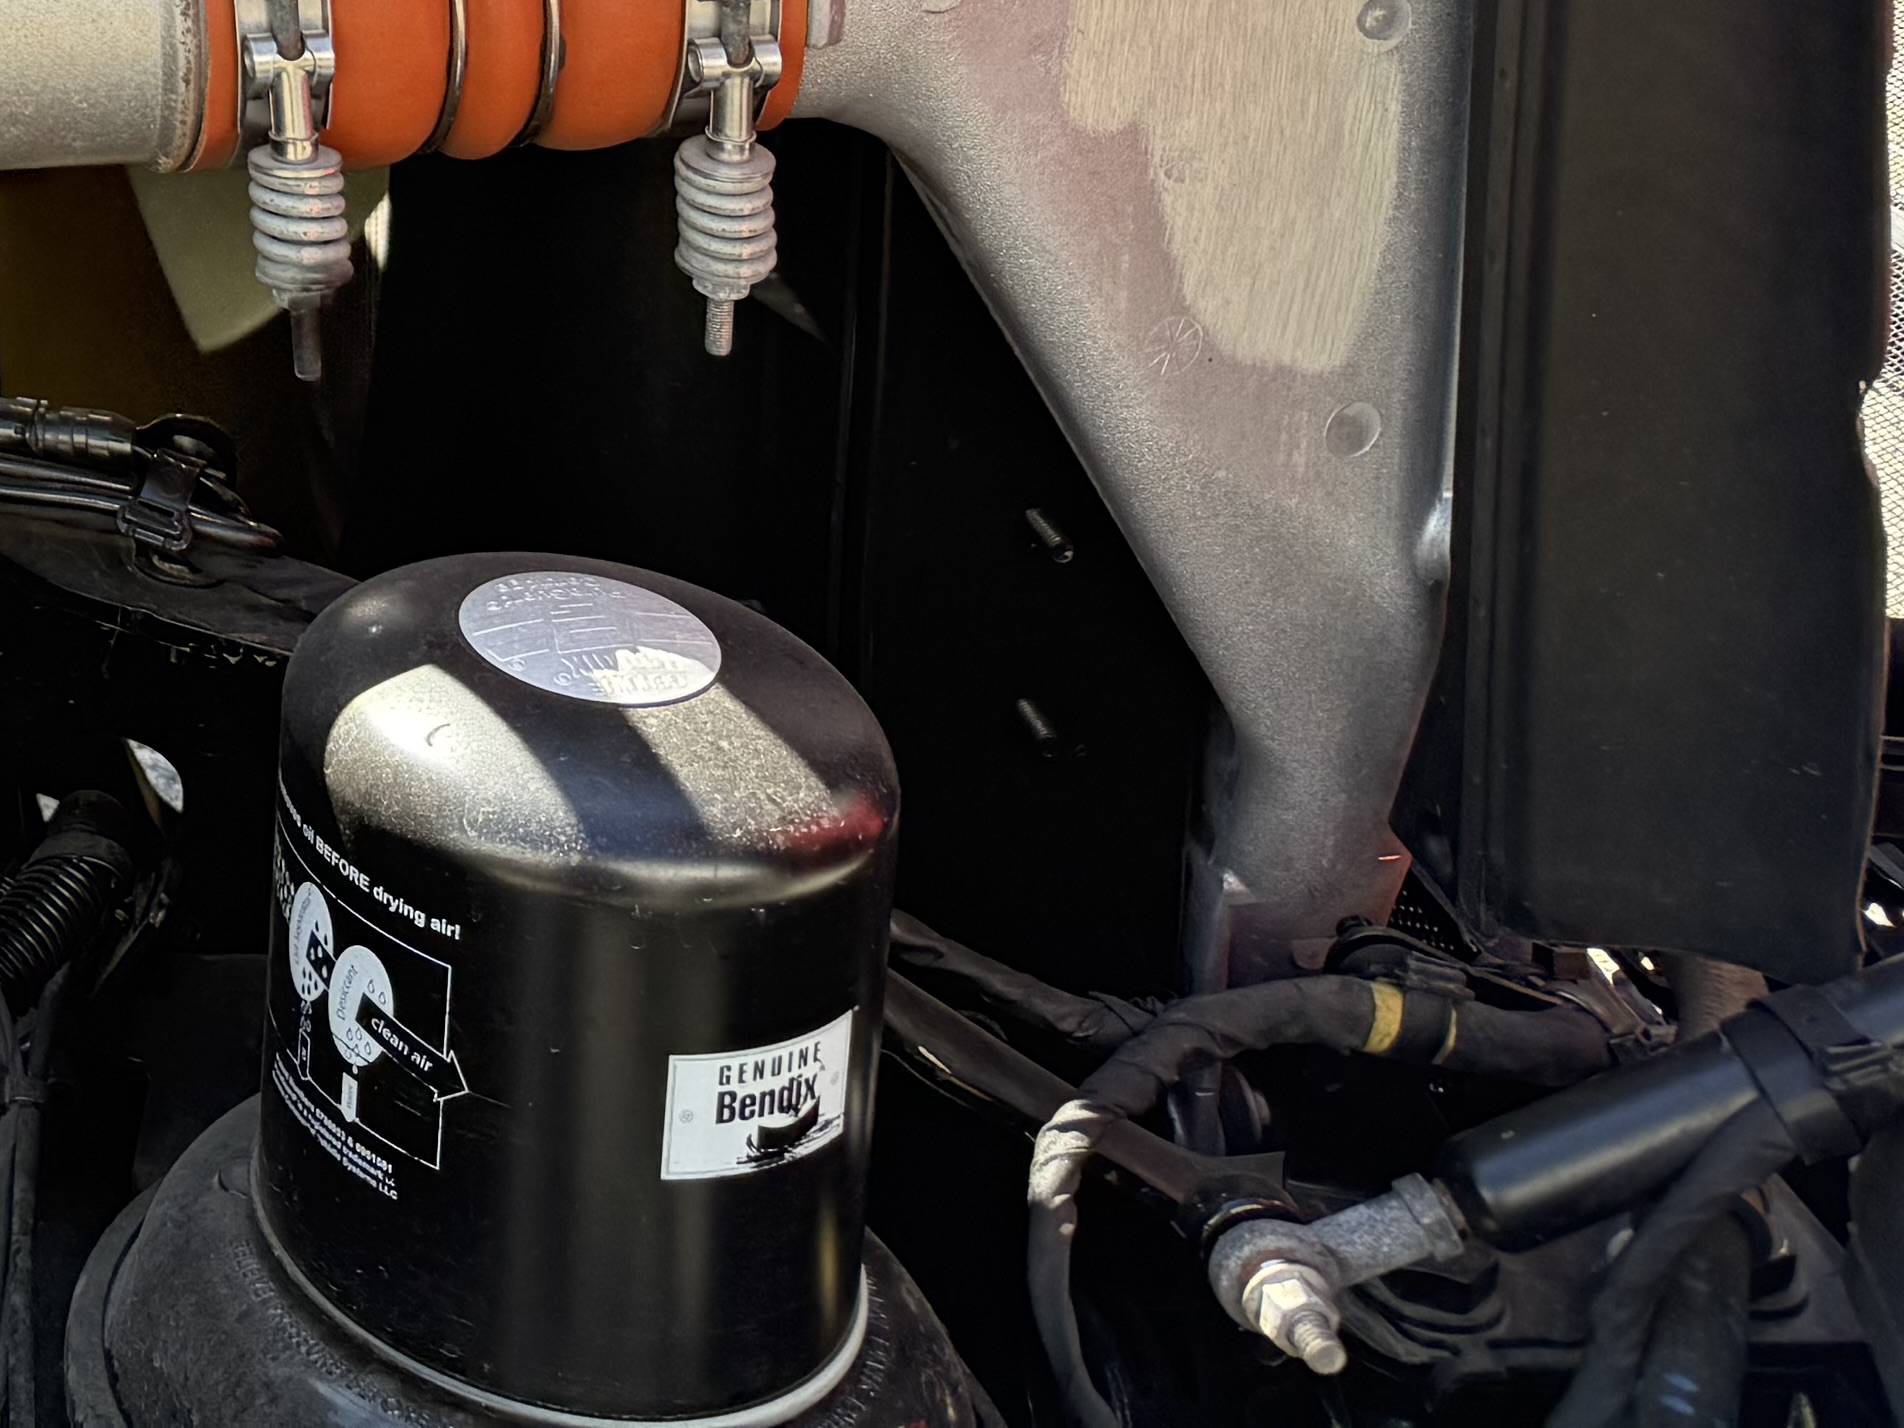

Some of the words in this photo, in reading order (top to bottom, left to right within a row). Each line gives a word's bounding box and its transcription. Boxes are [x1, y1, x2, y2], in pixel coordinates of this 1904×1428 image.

[303, 823, 315, 845] oil
[315, 835, 371, 893] BEFORE
[372, 885, 427, 929] drying
[429, 917, 462, 940] air!
[335, 963, 359, 1021] Desiccant
[370, 1016, 410, 1056] clean
[410, 1053, 434, 1073] air
[718, 1040, 822, 1087] GENUINE
[715, 1073, 818, 1125] Bendix
[378, 1182, 398, 1201] LLC
